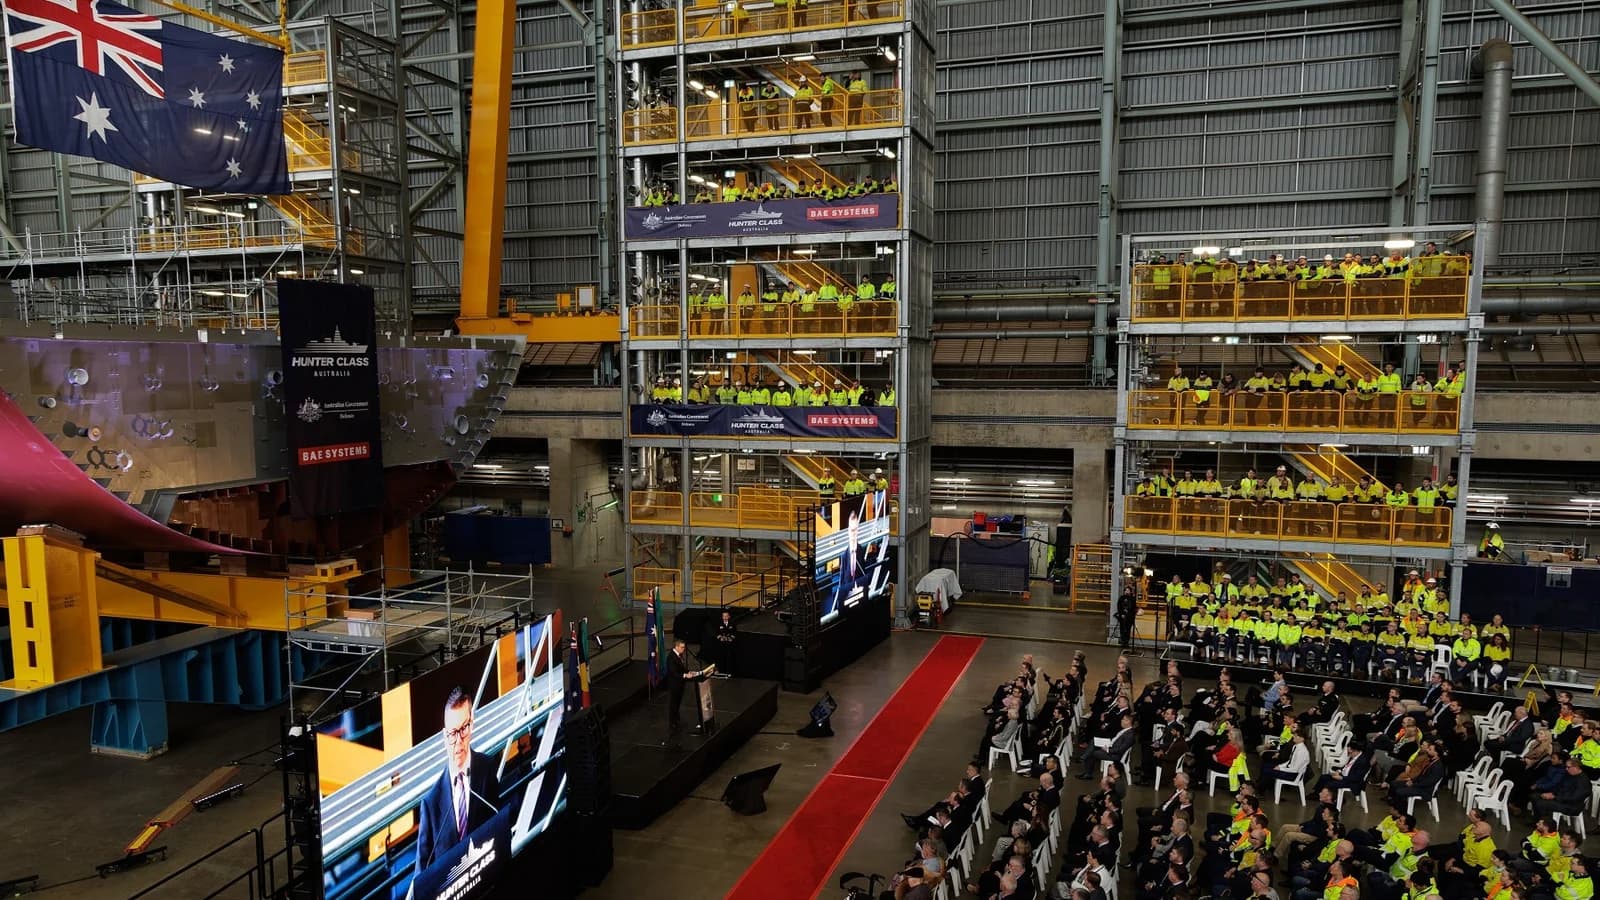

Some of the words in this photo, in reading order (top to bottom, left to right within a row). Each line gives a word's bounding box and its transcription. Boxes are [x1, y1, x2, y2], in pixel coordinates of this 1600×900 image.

[810, 209, 829, 217] BAE
[831, 207, 875, 217] SYSTEMS
[728, 219, 757, 227] HUNTER
[758, 218, 783, 226] CLASS
[292, 357, 335, 367] HUNTER
[336, 356, 369, 367] CLASS
[831, 417, 875, 425] SYSTEMS
[302, 450, 323, 461] BAE
[325, 445, 367, 458] SYSTEMS
[436, 871, 470, 900] HUNTER
[469, 849, 496, 878] CLASS
